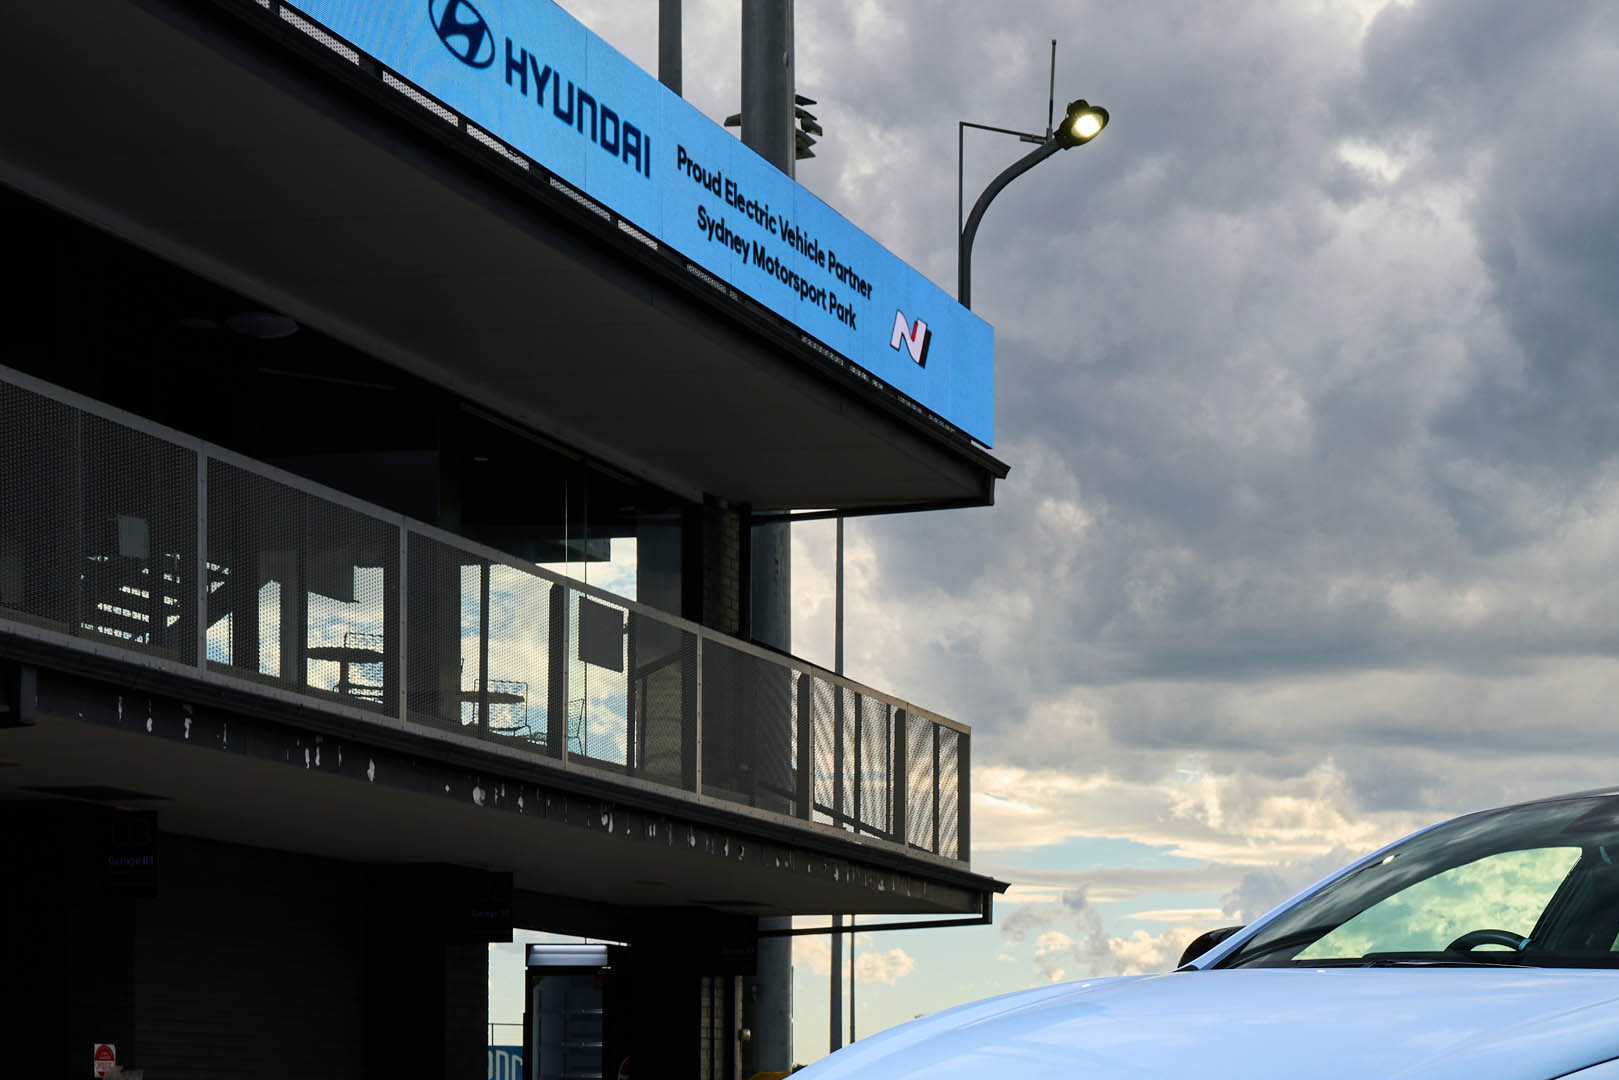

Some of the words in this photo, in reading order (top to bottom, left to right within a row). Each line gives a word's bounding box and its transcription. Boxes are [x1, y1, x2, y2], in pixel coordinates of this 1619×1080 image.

[505, 37, 651, 179] HYUNDAI
[677, 144, 722, 199] Proud
[724, 177, 777, 235] Electric
[778, 215, 826, 268] Vehicle
[827, 249, 873, 301] Partner
[697, 204, 751, 265] Sydney
[752, 239, 827, 311] Motorsport
[828, 291, 857, 331] Park
